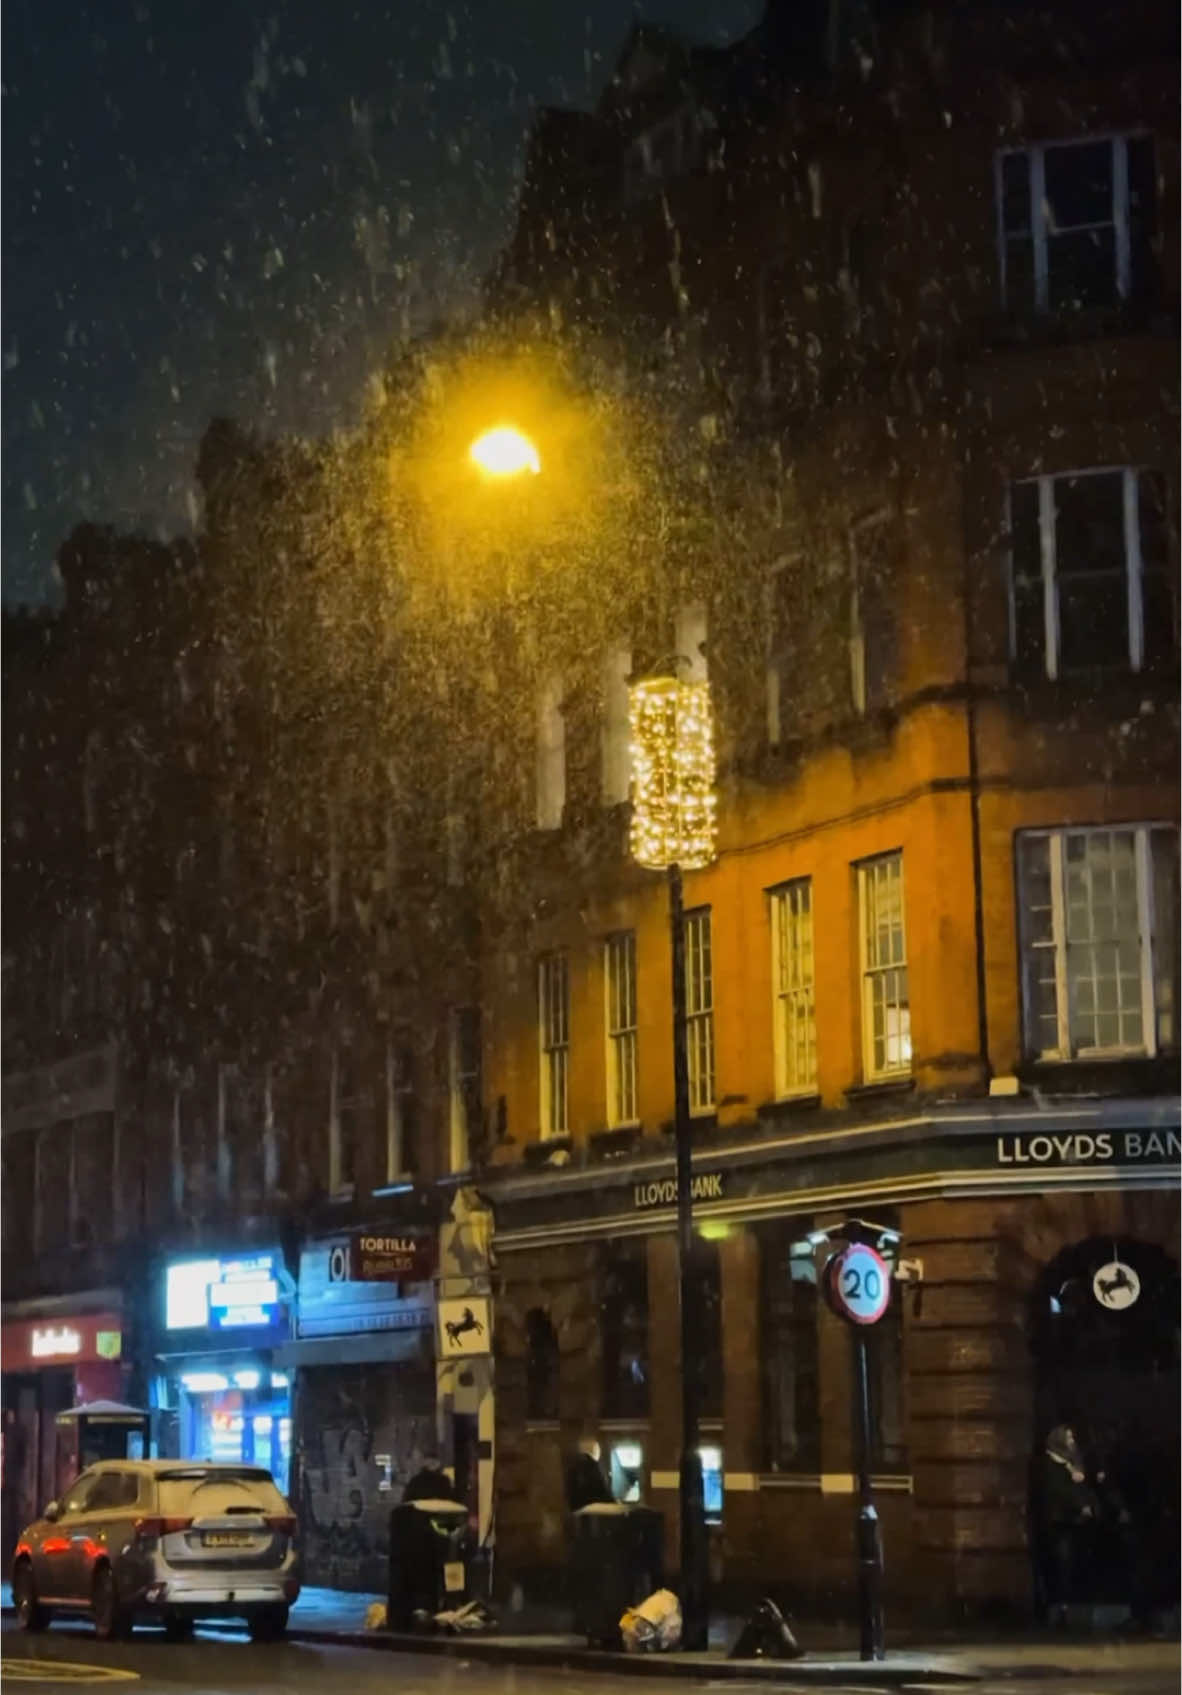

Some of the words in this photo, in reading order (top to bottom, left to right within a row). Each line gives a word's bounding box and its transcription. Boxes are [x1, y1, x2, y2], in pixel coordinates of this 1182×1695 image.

[997, 1134, 1113, 1163] LLOYDS
[360, 1237, 416, 1252] TORTILLA
[843, 1268, 879, 1300] 20
